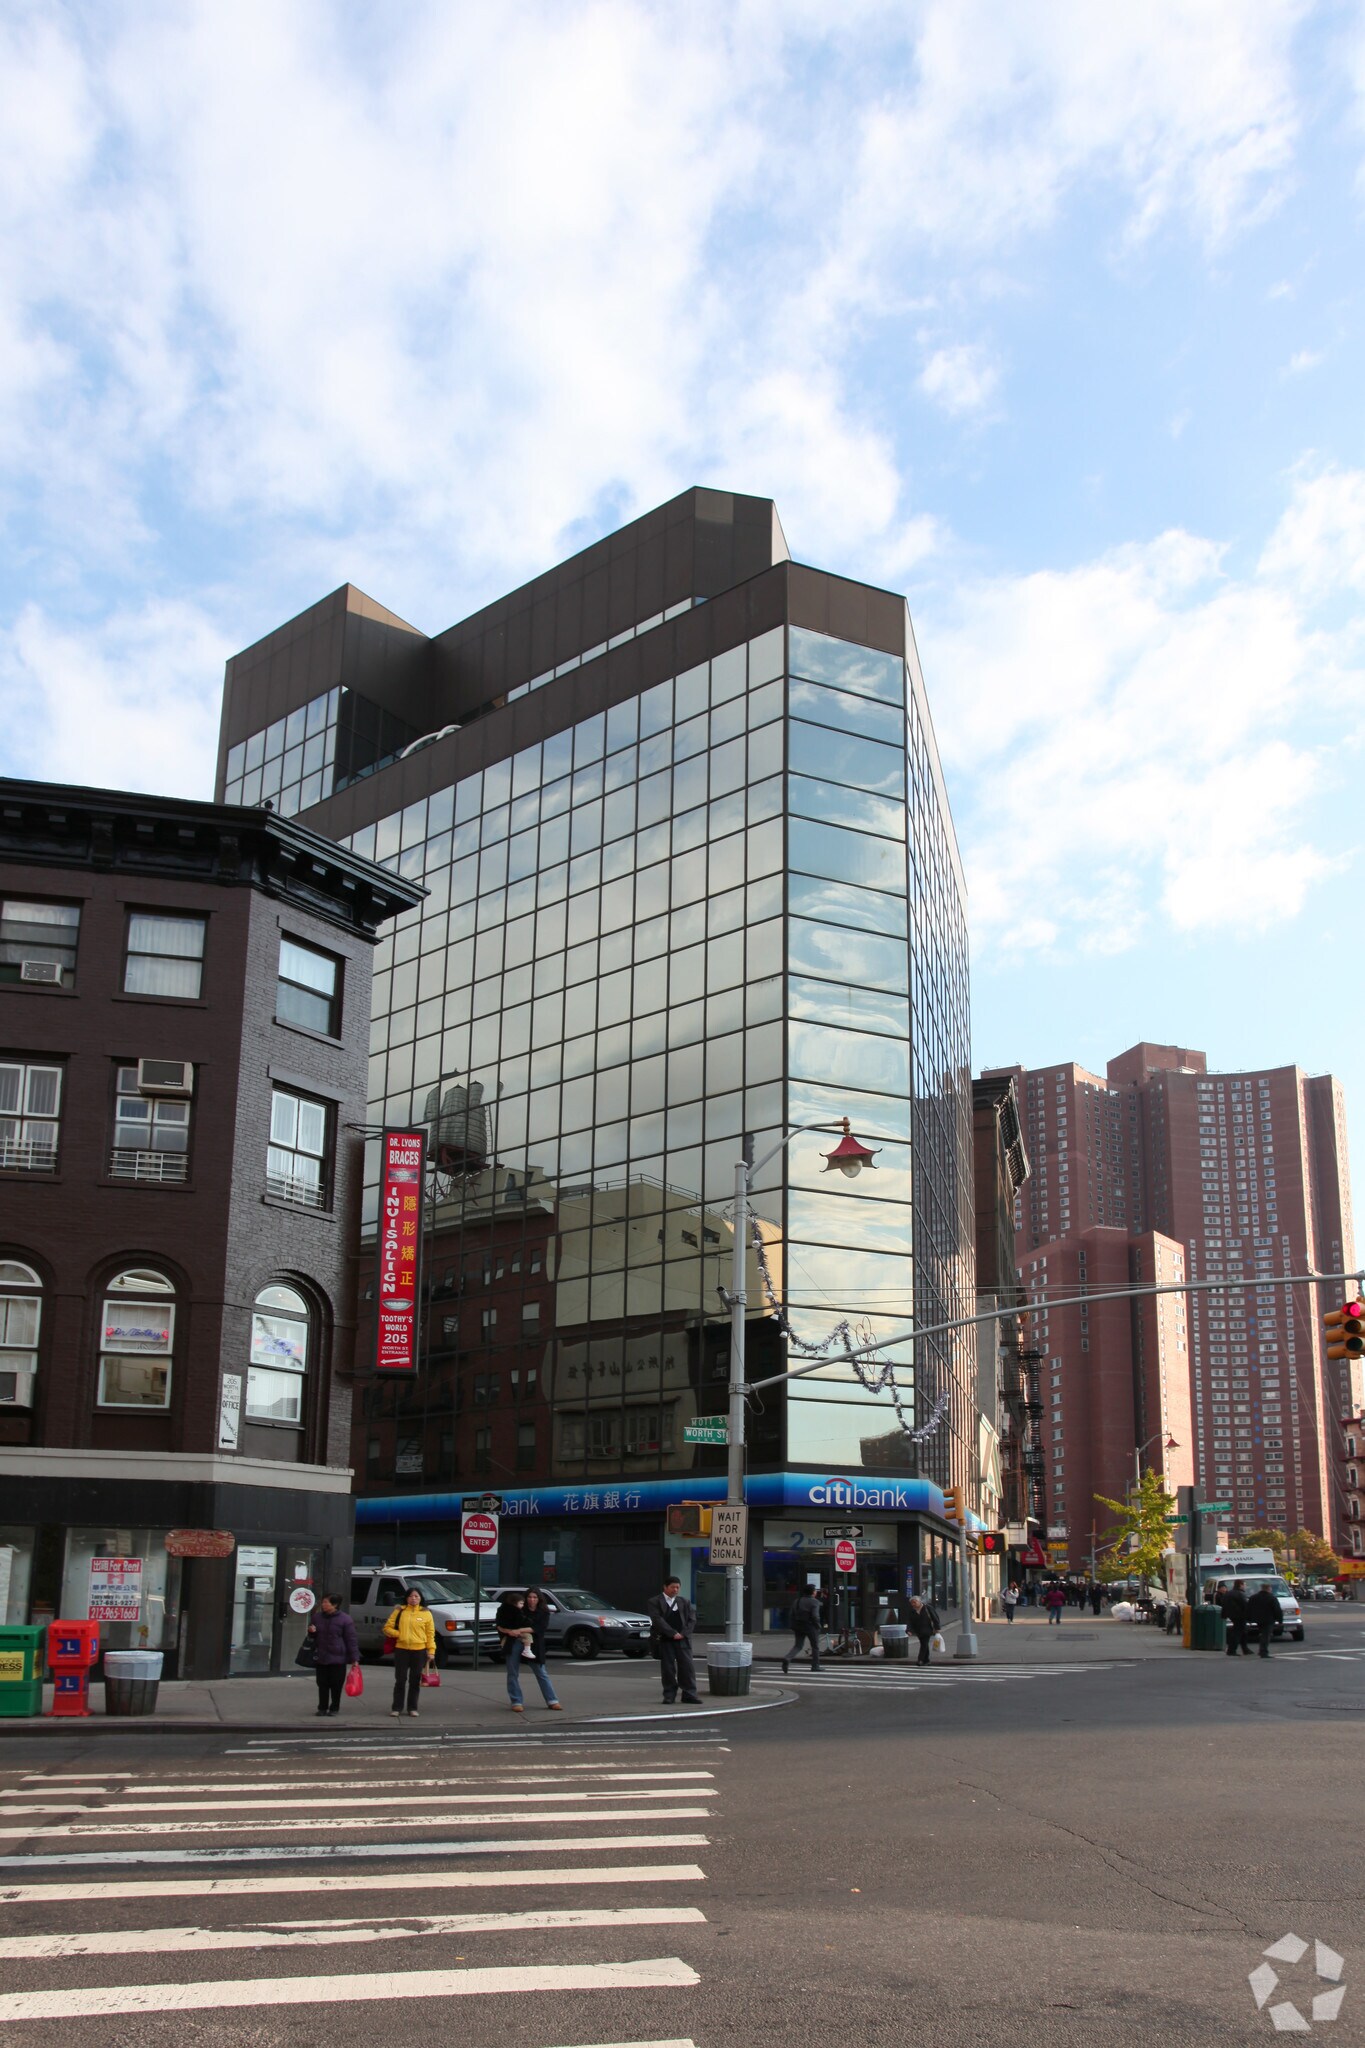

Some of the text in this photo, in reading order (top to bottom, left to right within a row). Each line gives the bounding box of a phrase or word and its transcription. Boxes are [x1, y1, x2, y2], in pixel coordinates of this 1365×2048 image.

[390, 1137, 421, 1148] DR. LYONS
[389, 1150, 419, 1165] BRACES
[381, 1315, 413, 1323] TOOTHY'S
[383, 1333, 408, 1344] 205
[227, 1377, 238, 1385] 205
[222, 1400, 240, 1410] OFFICE
[691, 1418, 713, 1427] MOTT
[685, 1429, 713, 1438] WORTH
[808, 1482, 908, 1508] citibank
[499, 1494, 540, 1516] bank
[563, 1490, 641, 1512] 花旗銀行
[717, 1511, 741, 1521] WAIT
[468, 1520, 492, 1529] DO NOT
[719, 1524, 738, 1534] FOR
[469, 1538, 490, 1547] ENTER
[714, 1536, 742, 1546] WALK
[790, 1531, 804, 1552] 2
[808, 1538, 834, 1546] MOTT
[712, 1548, 743, 1559] SIGNAL
[110, 1560, 122, 1571] For
[123, 1560, 140, 1572] Rent
[90, 1606, 137, 1619] 212-965-1668
[66, 1641, 75, 1651] L
[65, 1678, 74, 1688] L
